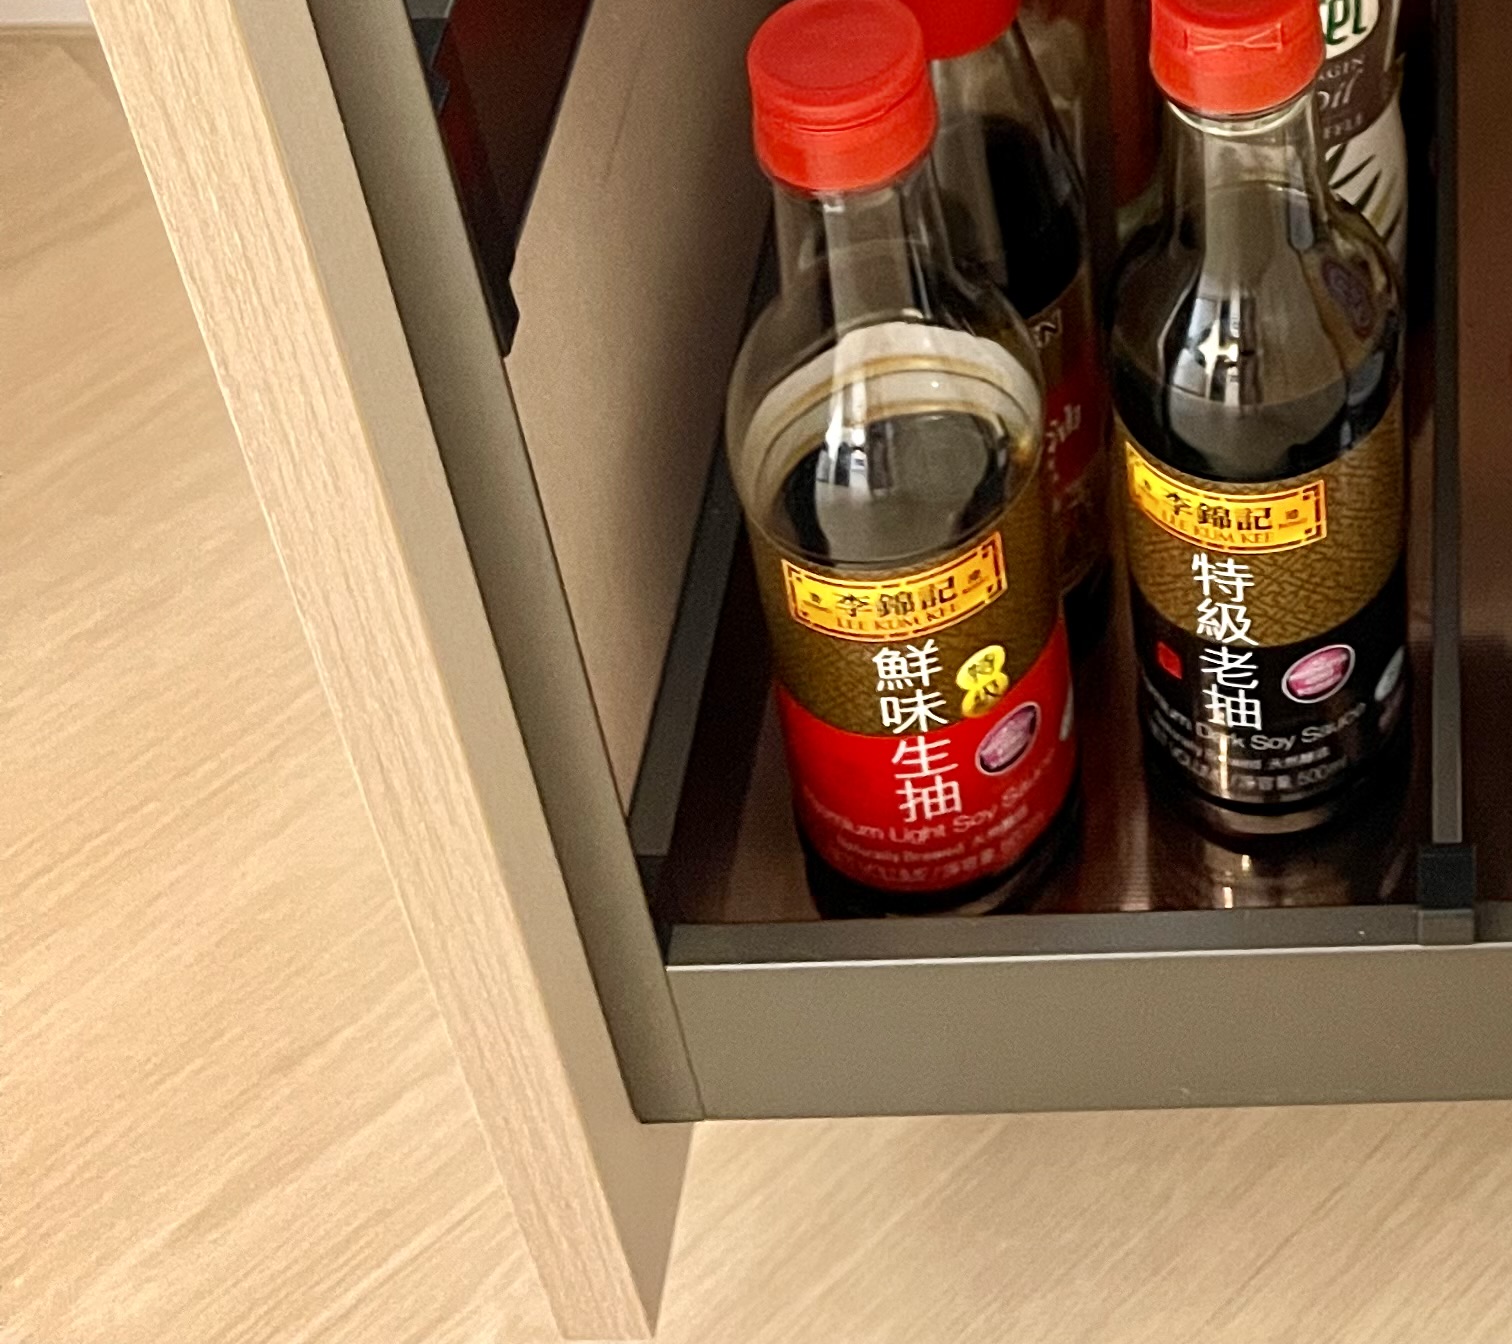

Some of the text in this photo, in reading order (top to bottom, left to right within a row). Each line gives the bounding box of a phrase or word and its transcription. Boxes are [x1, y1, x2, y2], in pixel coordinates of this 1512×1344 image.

[1160, 487, 1273, 531] 李錦記
[832, 575, 958, 618] 李錦記
[1191, 552, 1263, 732] 特級老抽
[871, 639, 963, 824] 鮮味生抽
[1250, 734, 1297, 752] Soy
[889, 824, 946, 845] Light
